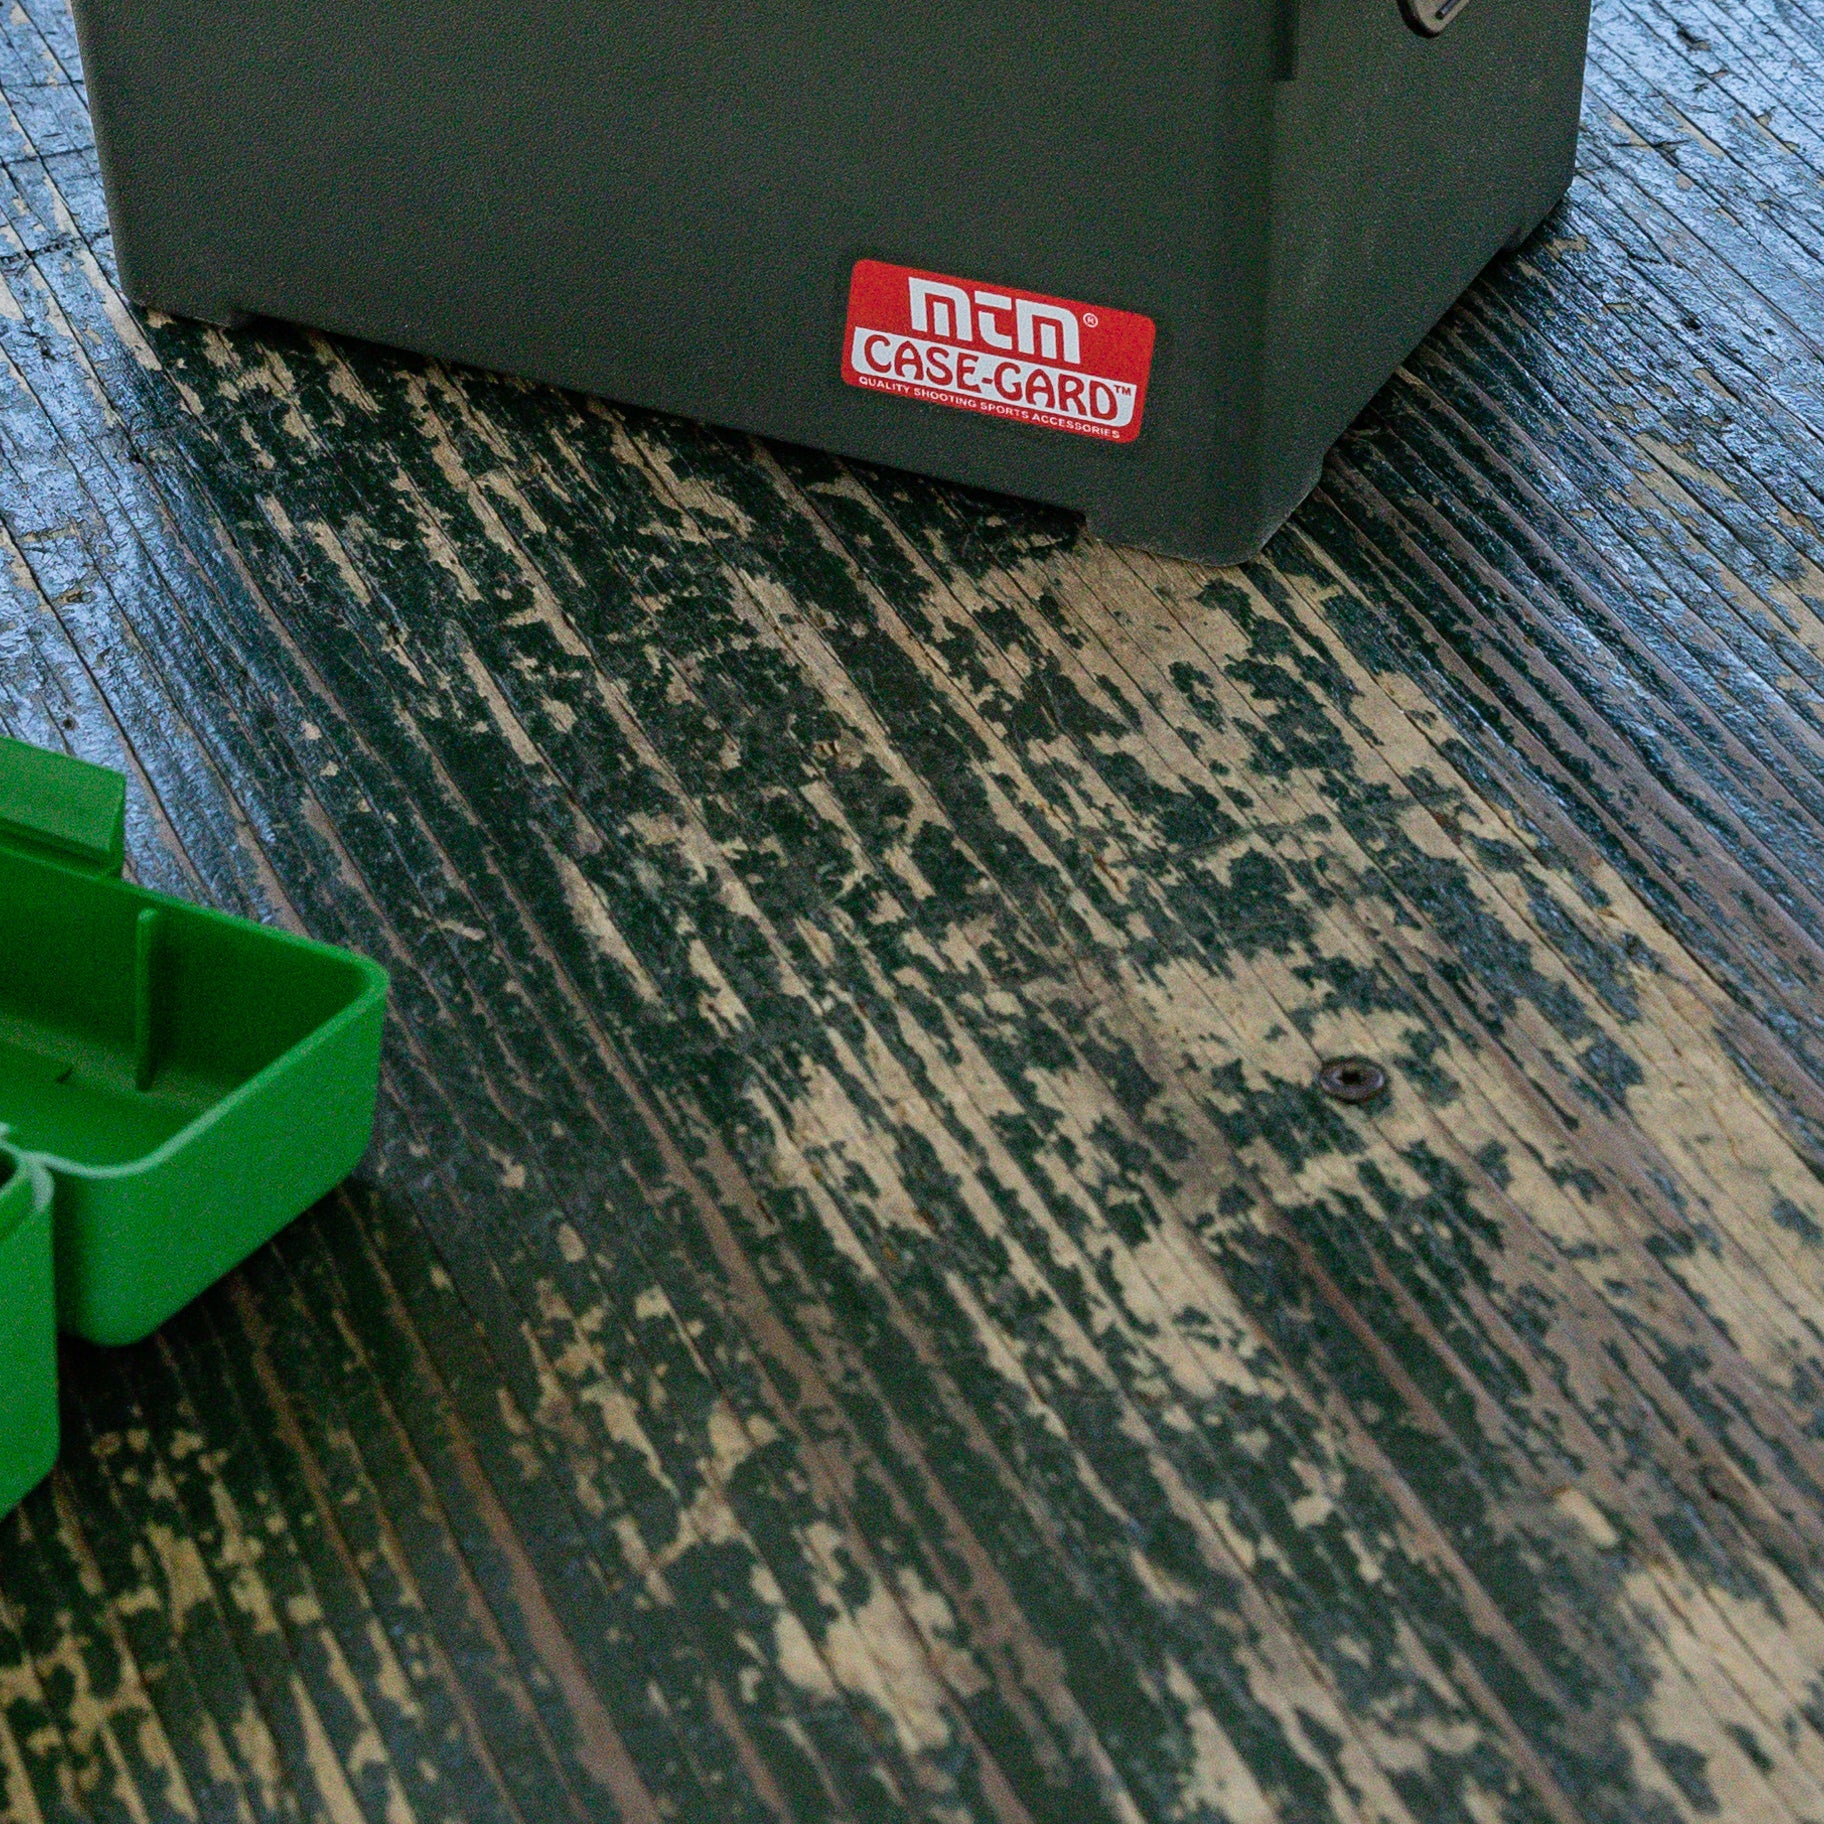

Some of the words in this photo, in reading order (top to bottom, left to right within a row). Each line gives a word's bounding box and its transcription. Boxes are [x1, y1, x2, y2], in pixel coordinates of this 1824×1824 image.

[858, 375, 911, 394] QUALITY
[913, 387, 977, 408] SHOOTING
[979, 401, 1029, 419] SPORTS
[1031, 413, 1121, 439] ACCESSORIES
